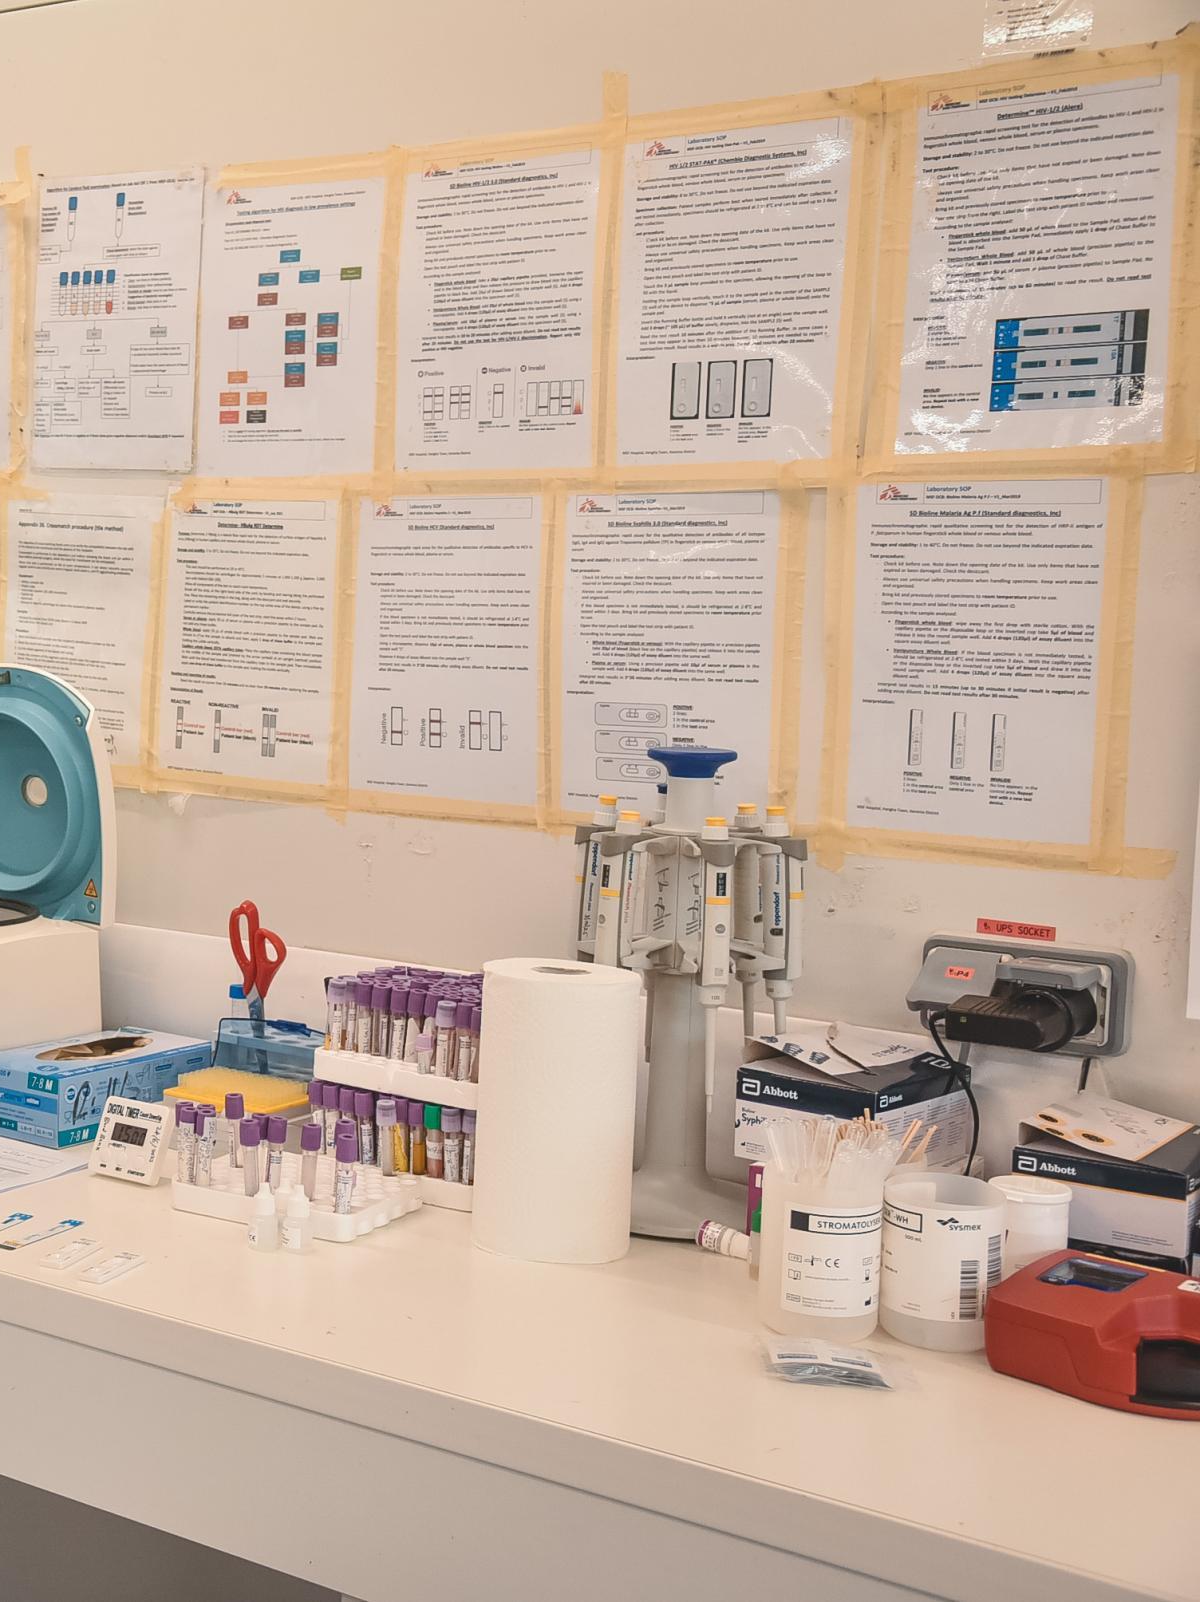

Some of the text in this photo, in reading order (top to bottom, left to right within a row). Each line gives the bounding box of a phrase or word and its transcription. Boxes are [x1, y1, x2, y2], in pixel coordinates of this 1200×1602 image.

[926, 486, 958, 494] Laboratory
[591, 842, 599, 876] eppendorf
[773, 891, 781, 926] eppendorf
[996, 923, 1051, 938] UPS SOCKET
[31, 1076, 54, 1090] 7-8 M
[762, 1085, 799, 1100] Abbott
[107, 1103, 124, 1116] DIGITAL
[126, 1106, 140, 1119] TIMER
[69, 1128, 89, 1143] 7-8 M
[1040, 1162, 1077, 1176] Abbott
[825, 1258, 840, 1268] CE
